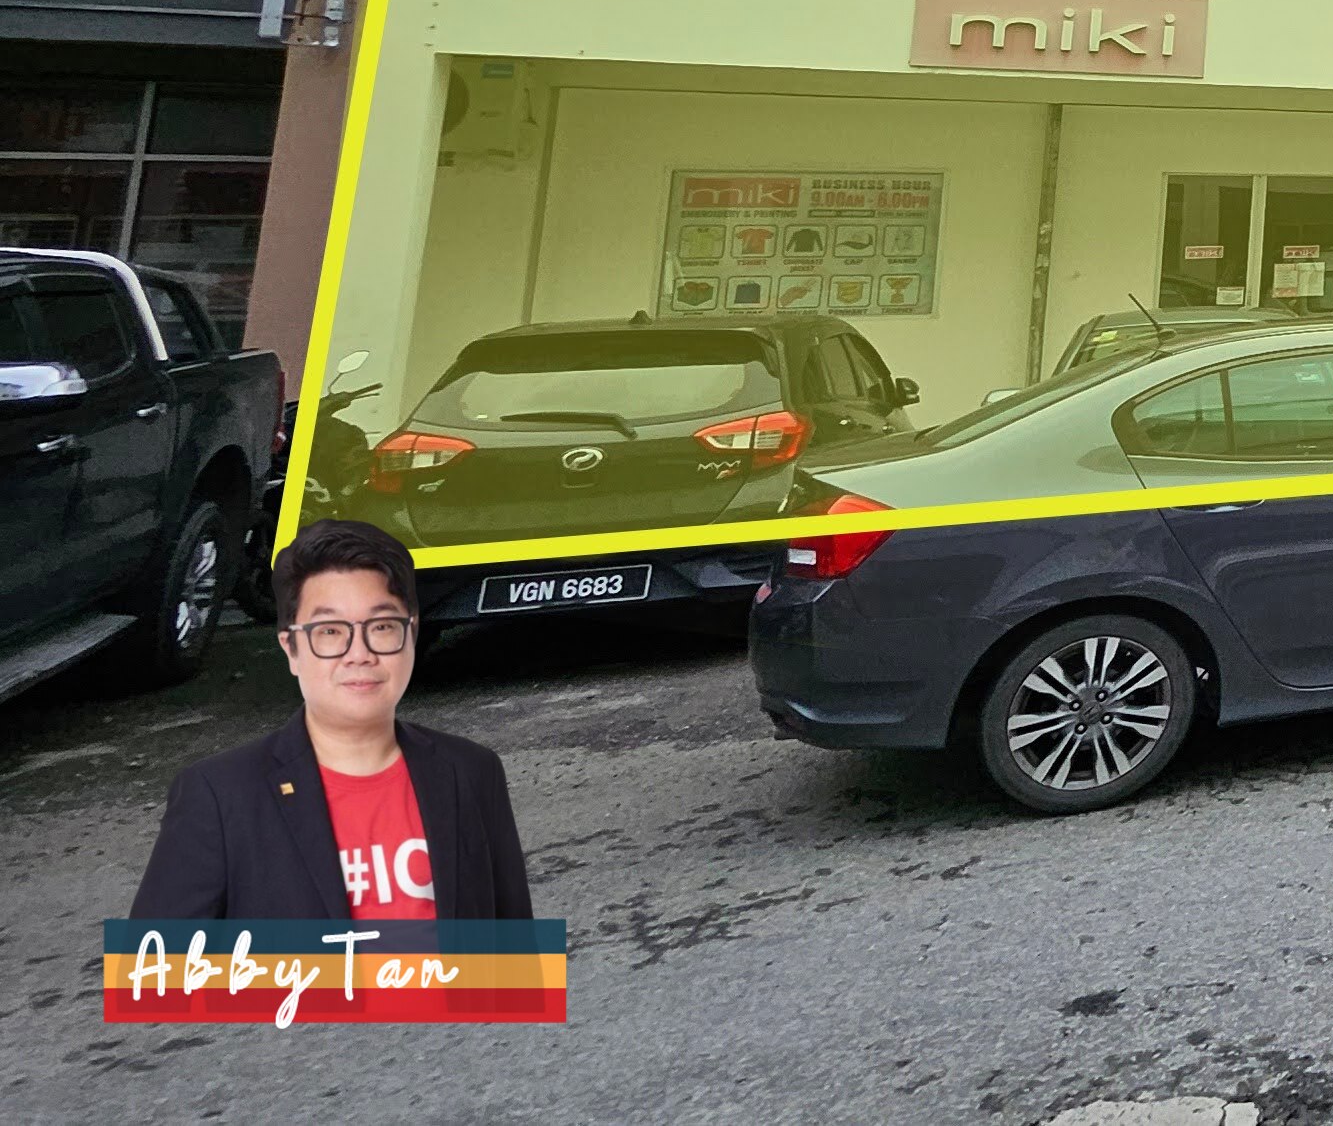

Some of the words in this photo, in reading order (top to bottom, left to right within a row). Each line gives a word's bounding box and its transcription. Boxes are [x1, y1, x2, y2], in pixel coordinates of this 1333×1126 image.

[949, 7, 1176, 56] miki
[686, 183, 796, 205] miki
[811, 179, 886, 190] BUSINESS
[891, 180, 931, 191] HOUR
[509, 580, 555, 604] VGN
[562, 574, 623, 599] 6683
